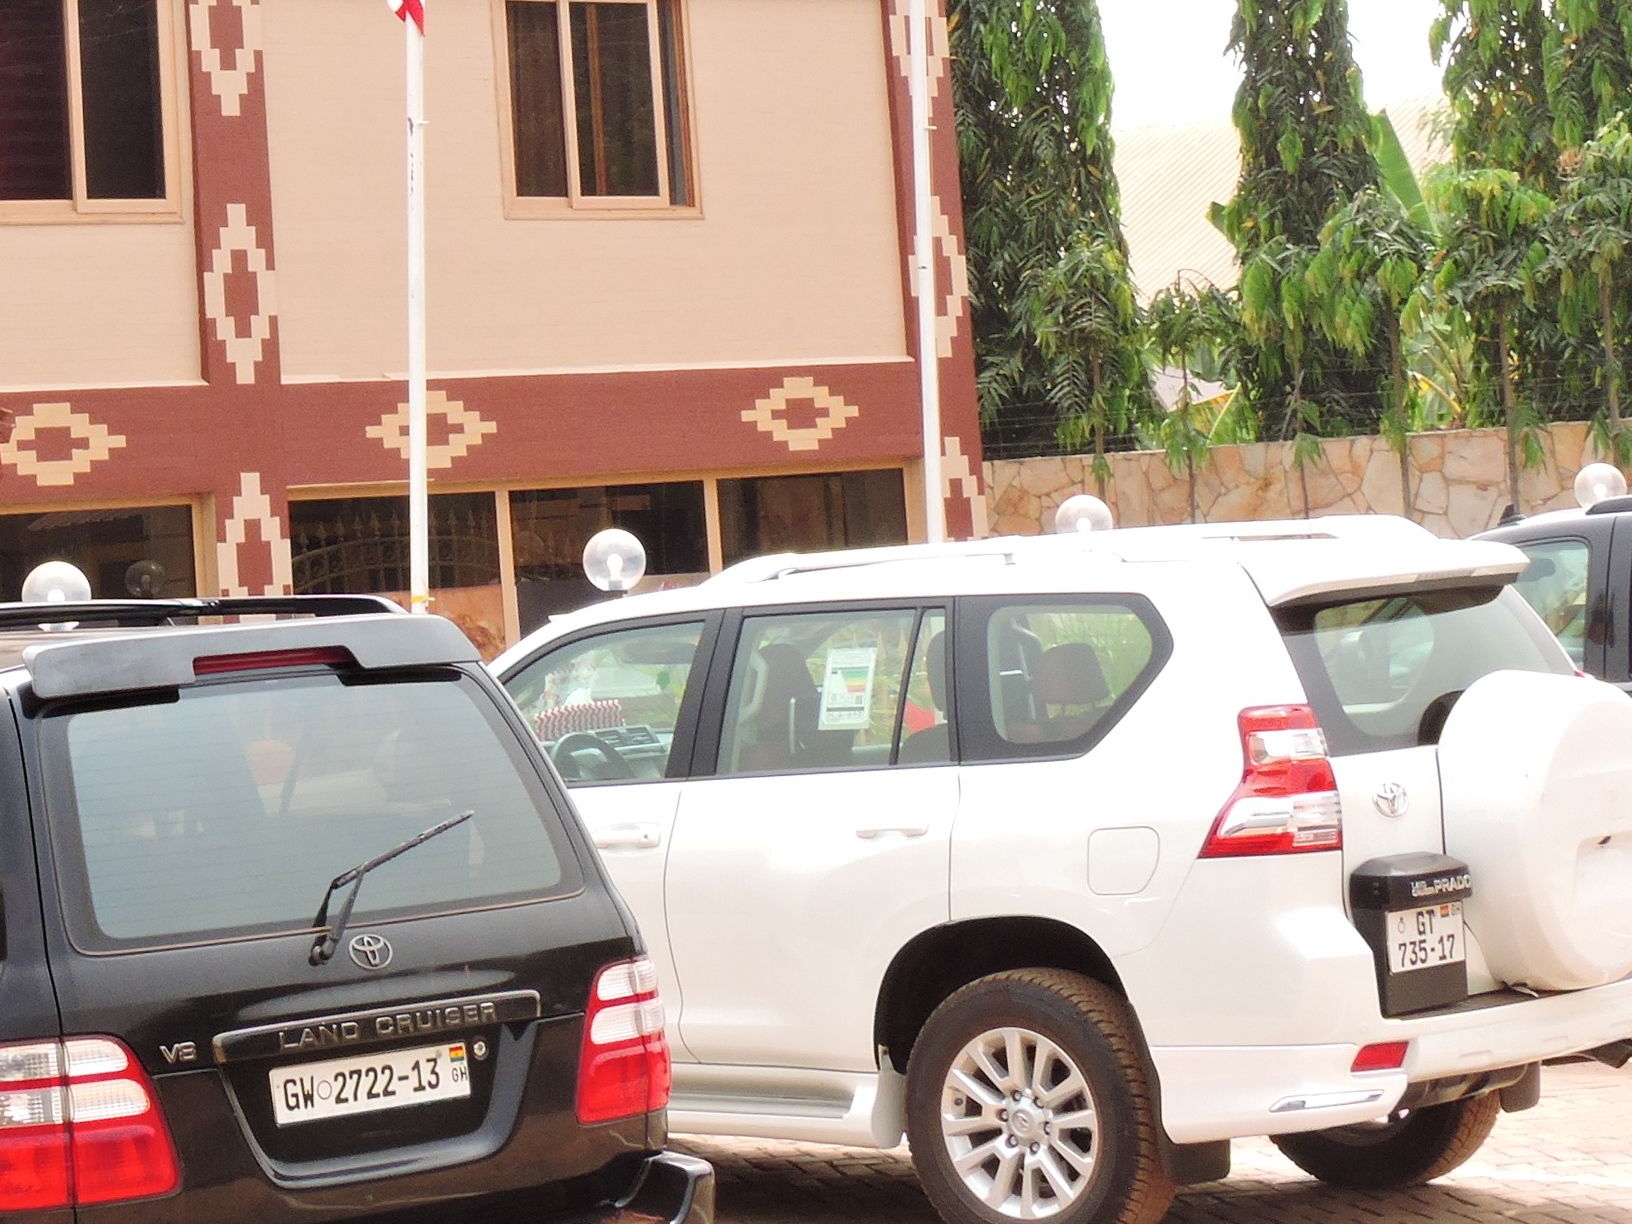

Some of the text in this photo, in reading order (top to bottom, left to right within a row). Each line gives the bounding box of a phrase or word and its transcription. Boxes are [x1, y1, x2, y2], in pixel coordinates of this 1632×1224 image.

[1417, 909, 1435, 936] GT
[1398, 934, 1455, 968] 735-17
[279, 1002, 496, 1049] LAND CRUISER
[284, 1059, 440, 1111] GW 2722-13
